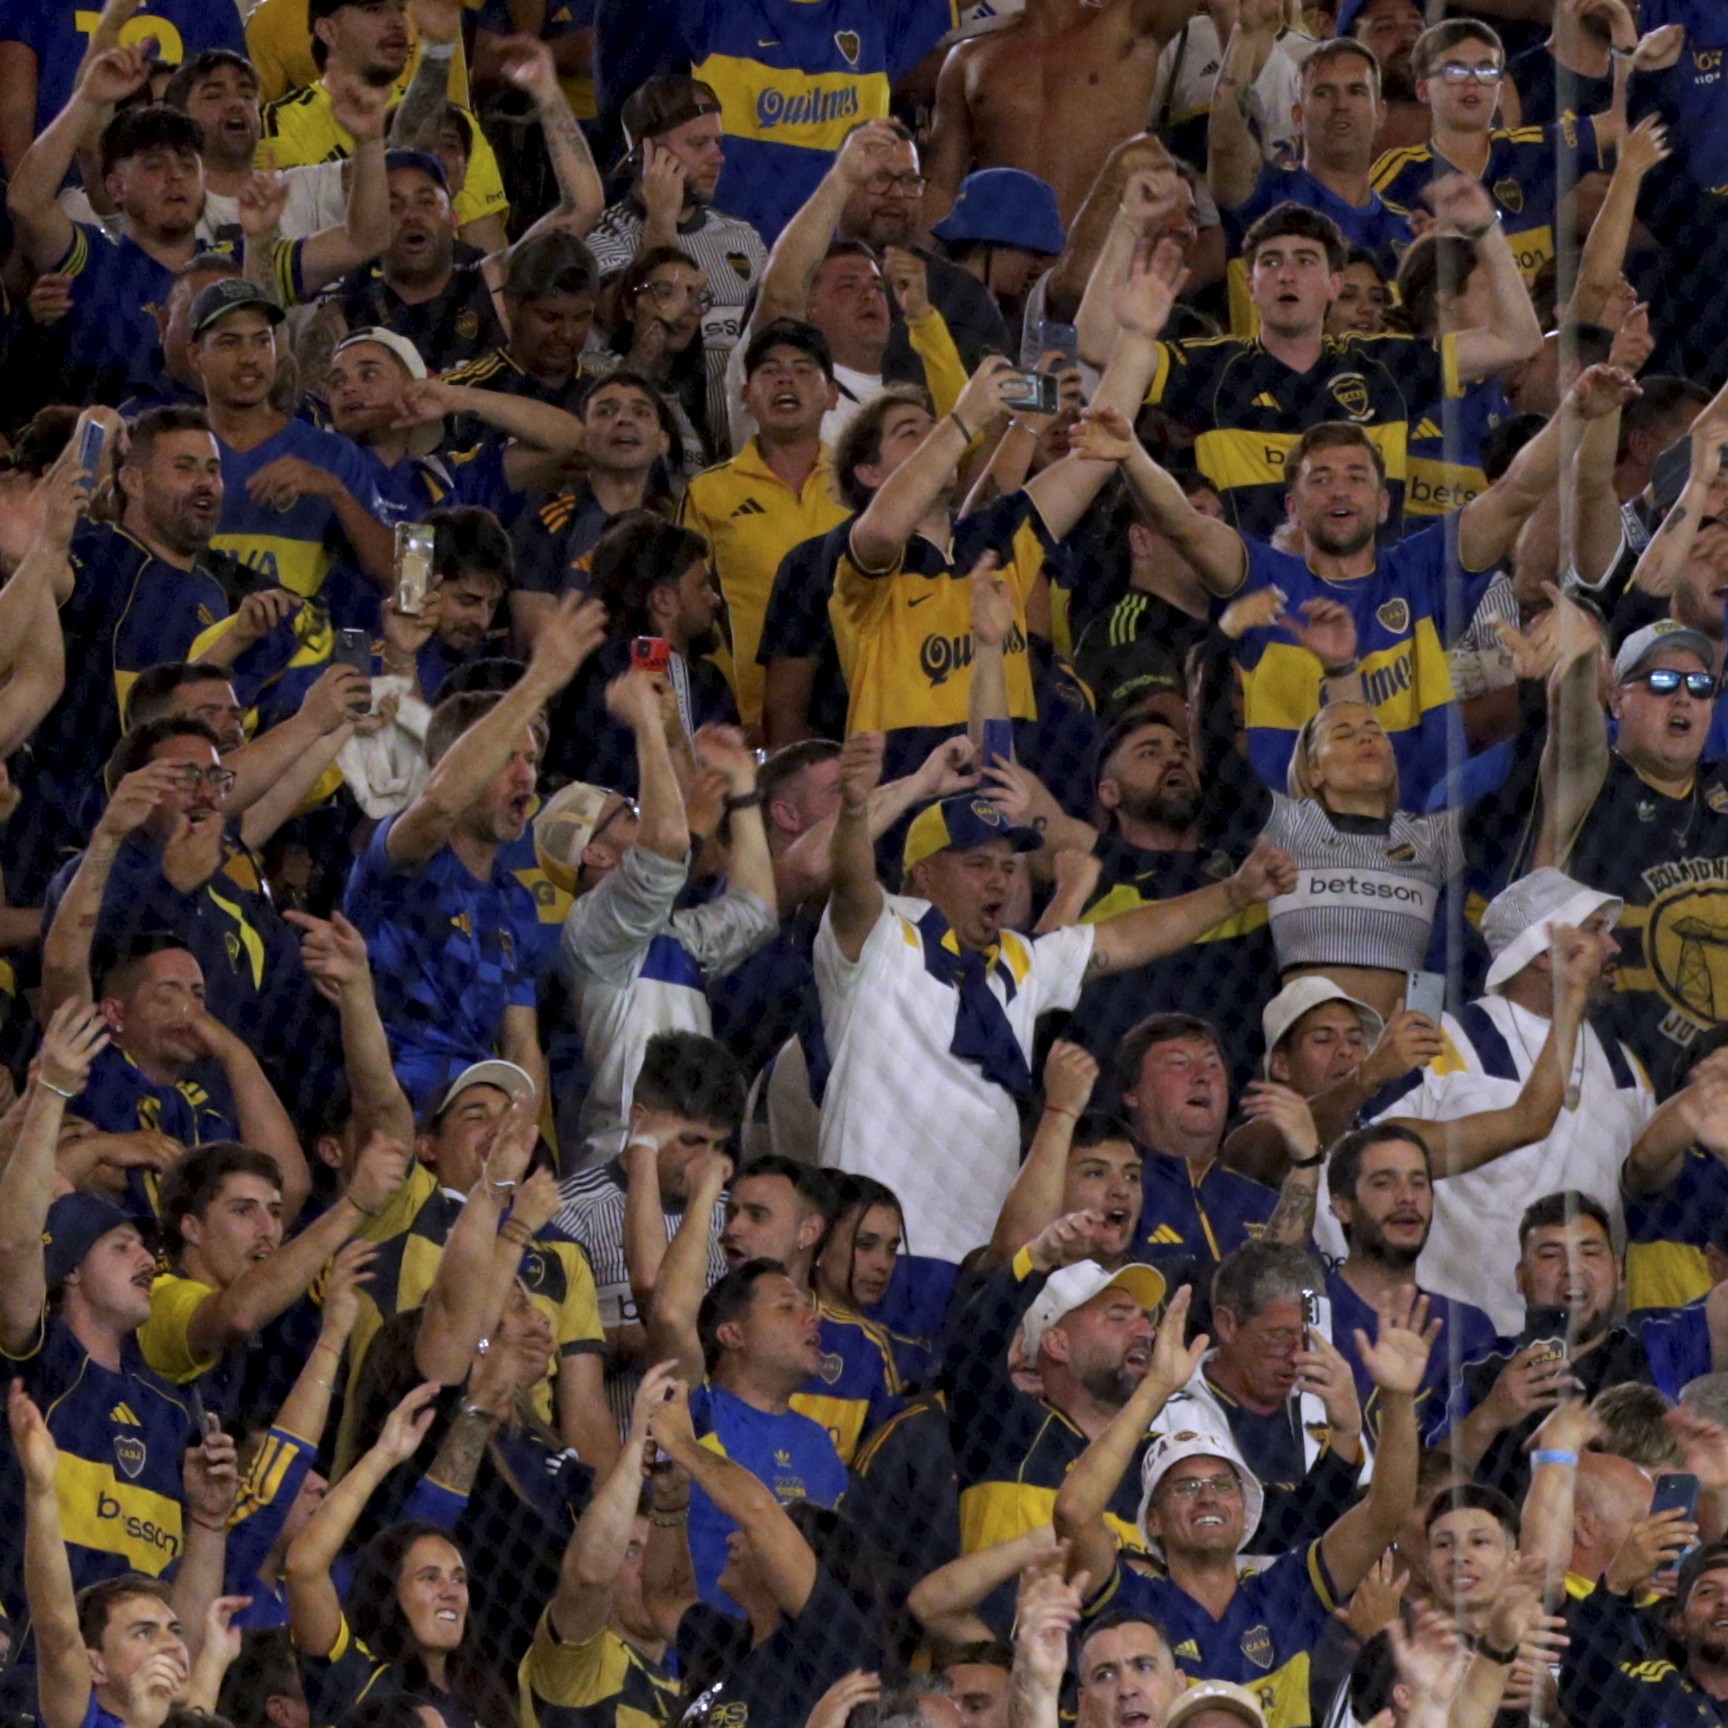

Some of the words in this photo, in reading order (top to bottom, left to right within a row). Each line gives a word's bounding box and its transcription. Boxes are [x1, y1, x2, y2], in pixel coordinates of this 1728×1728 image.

[756, 84, 859, 131] Quilmes
[1308, 875, 1423, 907] betsson
[97, 1489, 180, 1557] bsson
